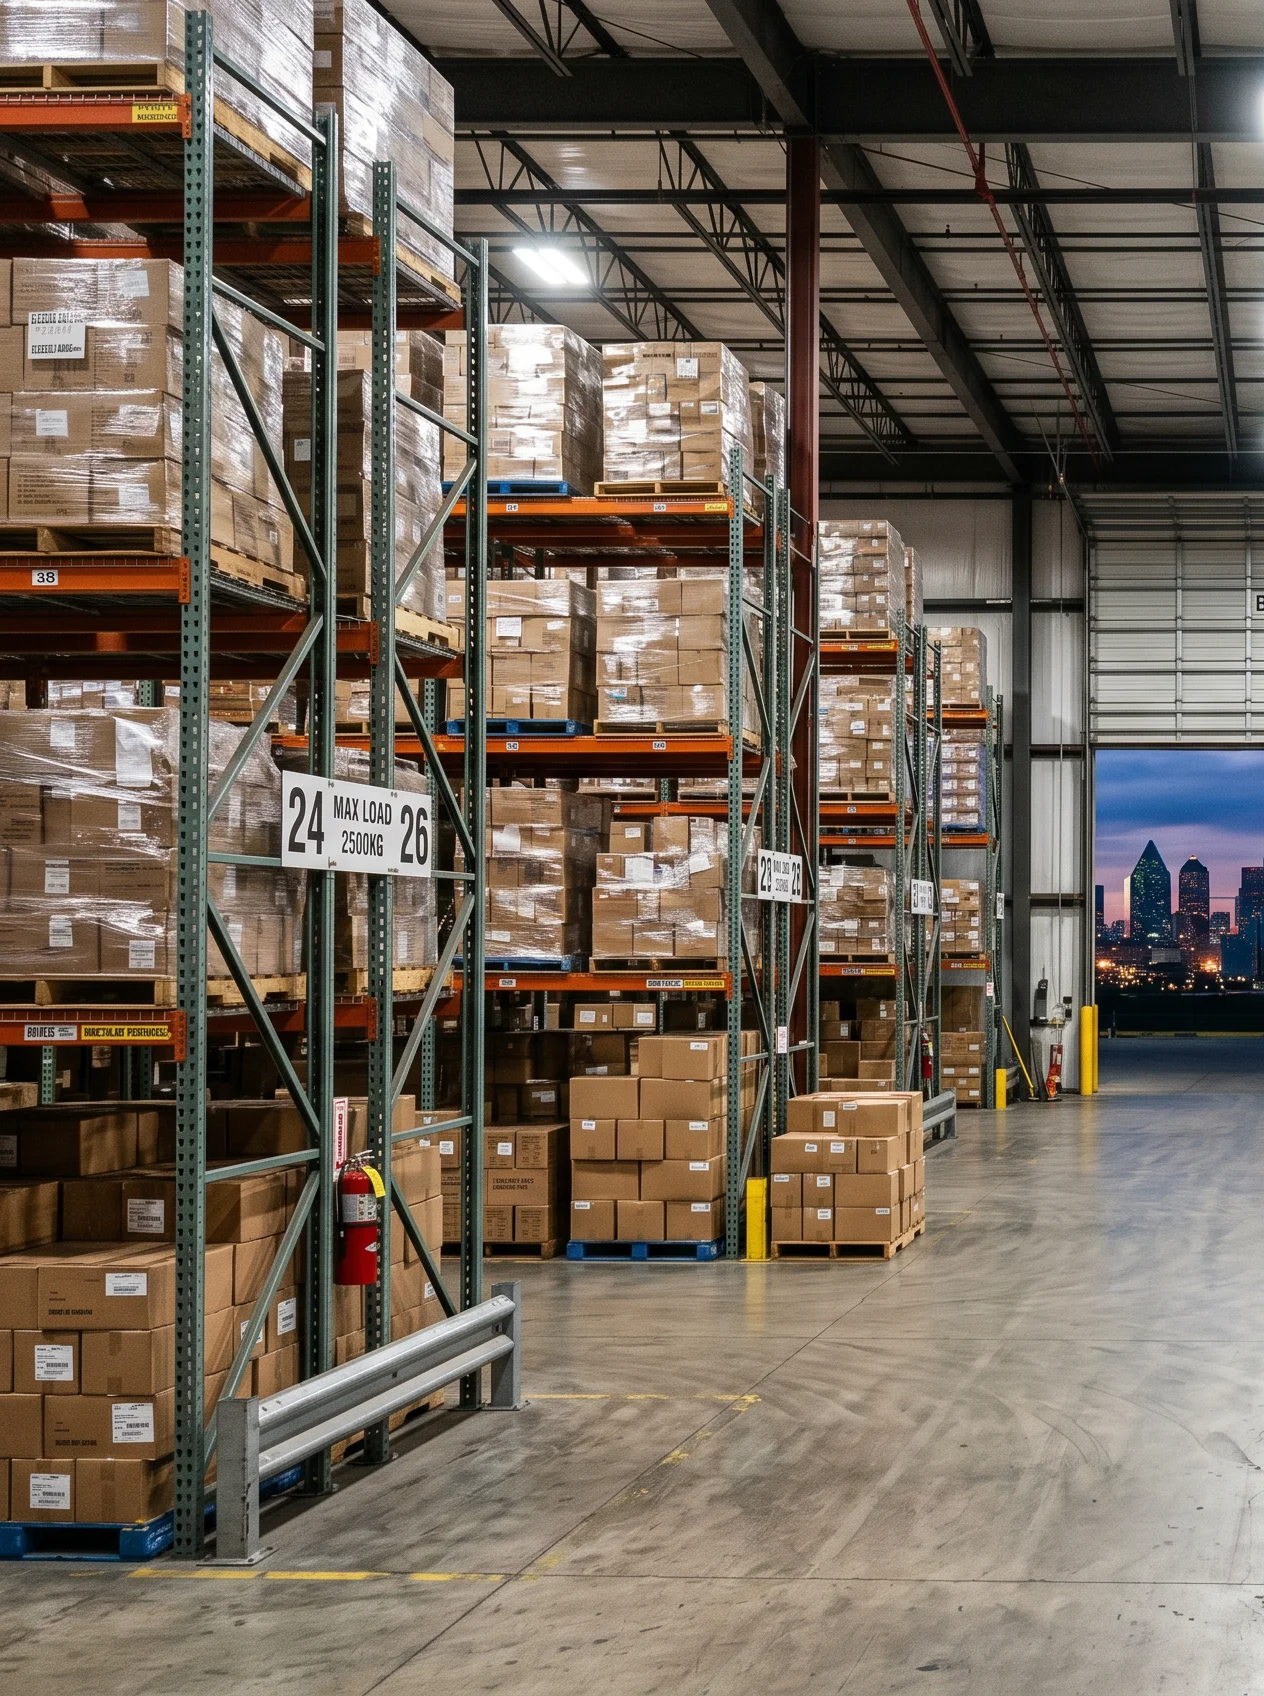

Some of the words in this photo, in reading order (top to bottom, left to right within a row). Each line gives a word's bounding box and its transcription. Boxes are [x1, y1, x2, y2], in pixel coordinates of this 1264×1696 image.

[37, 571, 56, 584] 38
[288, 786, 325, 855] 24
[333, 795, 359, 822] MAX
[363, 800, 392, 826] LOAD
[341, 830, 384, 857] 2500KG
[400, 804, 429, 866] 26
